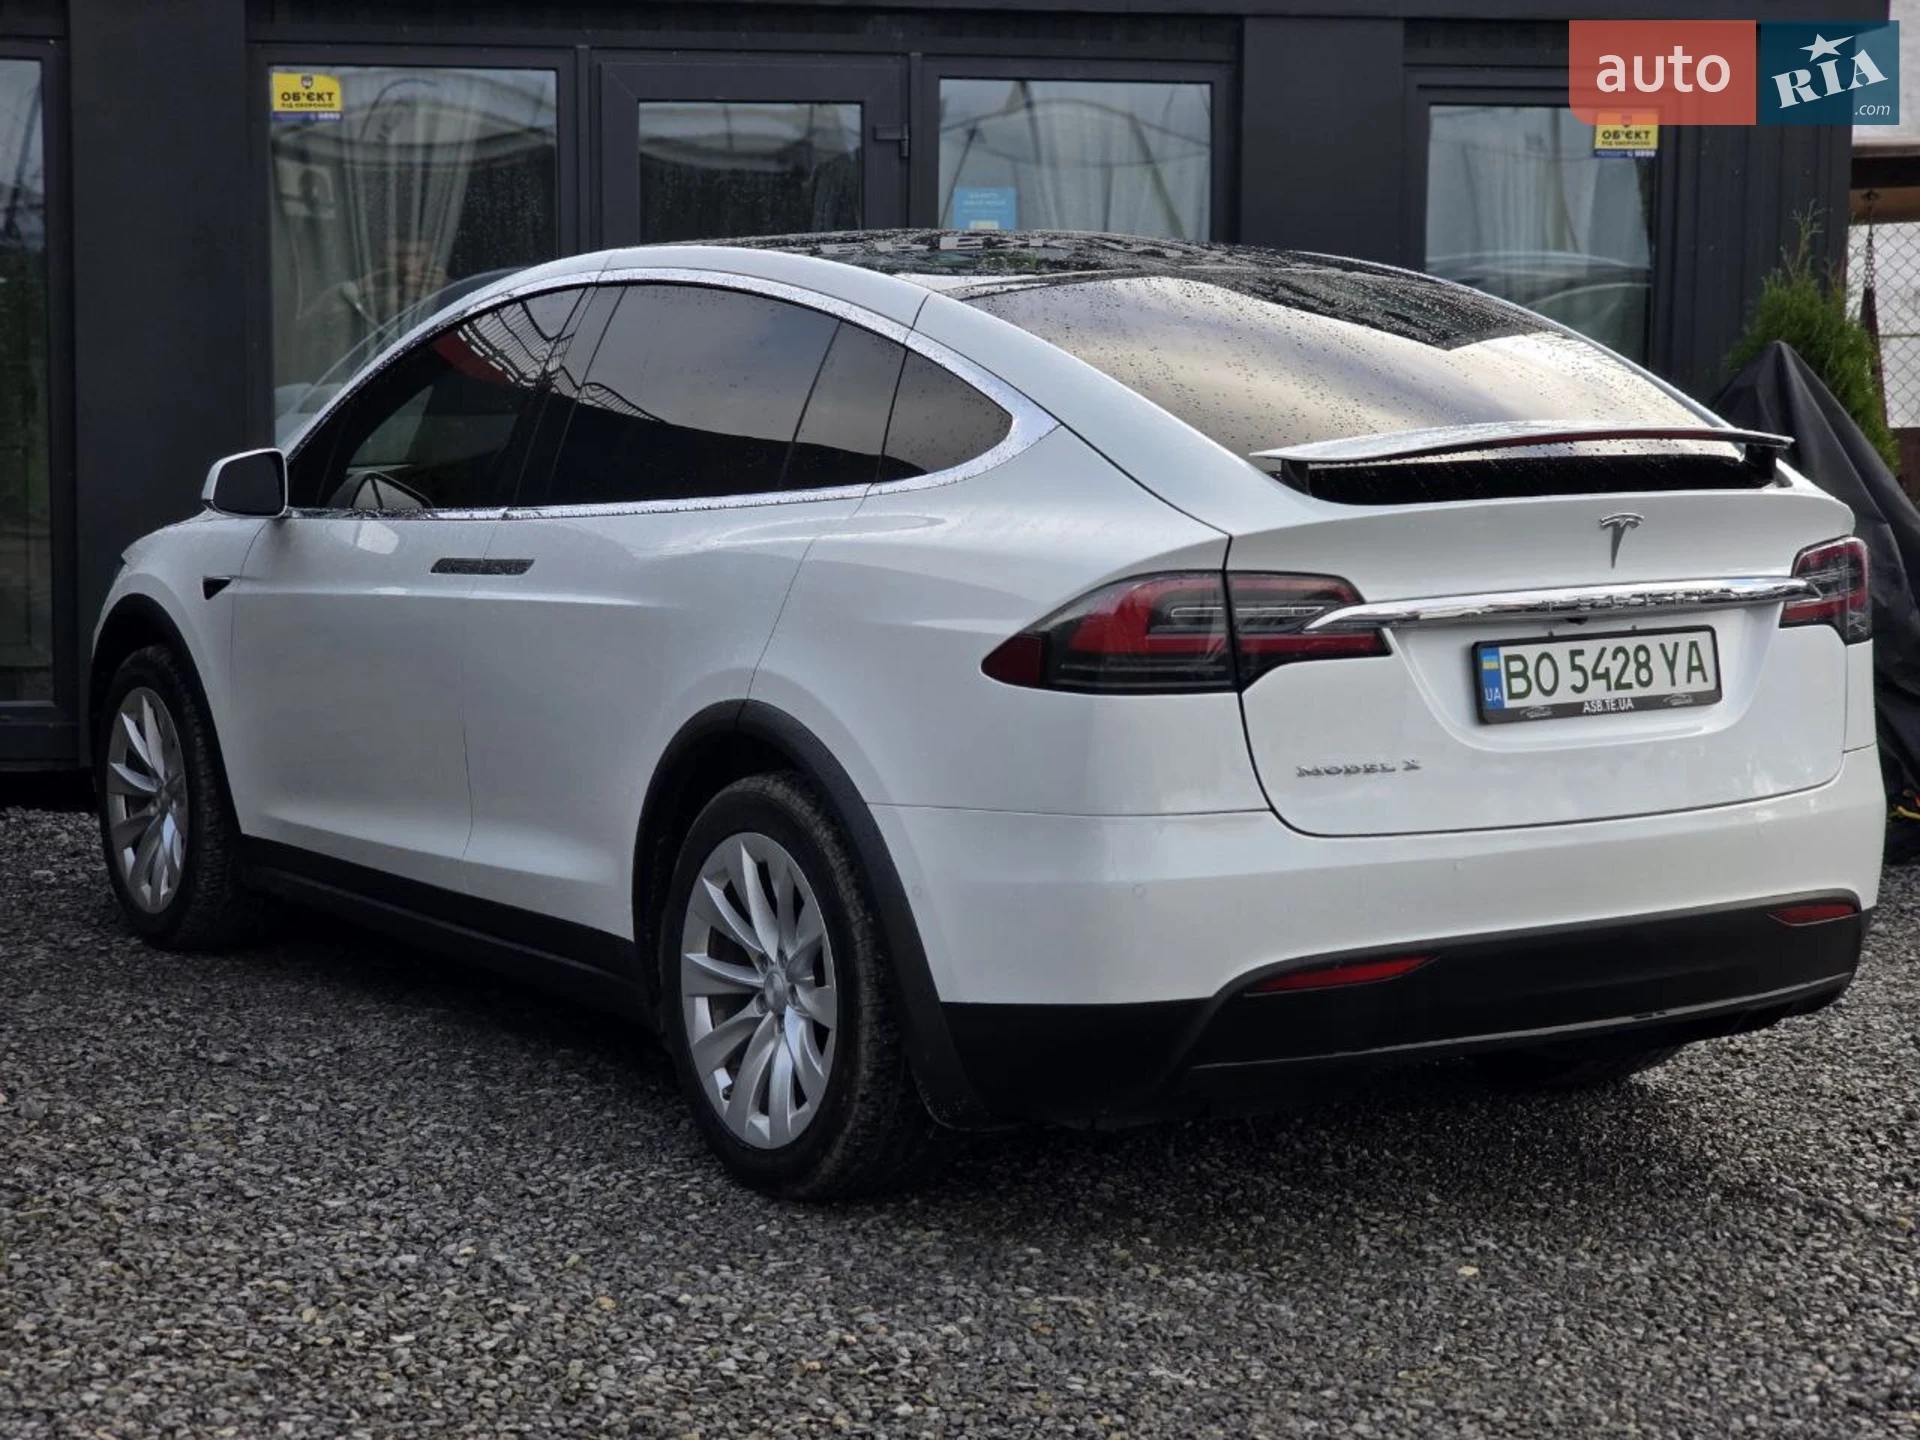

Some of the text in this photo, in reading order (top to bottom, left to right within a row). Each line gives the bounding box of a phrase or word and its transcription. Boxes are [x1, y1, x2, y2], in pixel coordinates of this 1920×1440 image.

[1504, 640, 1708, 700] BO 5428 YA
[1485, 688, 1502, 702] UA
[1582, 697, 1635, 714] ASB.TE.UA
[1296, 763, 1396, 777] MODEL
